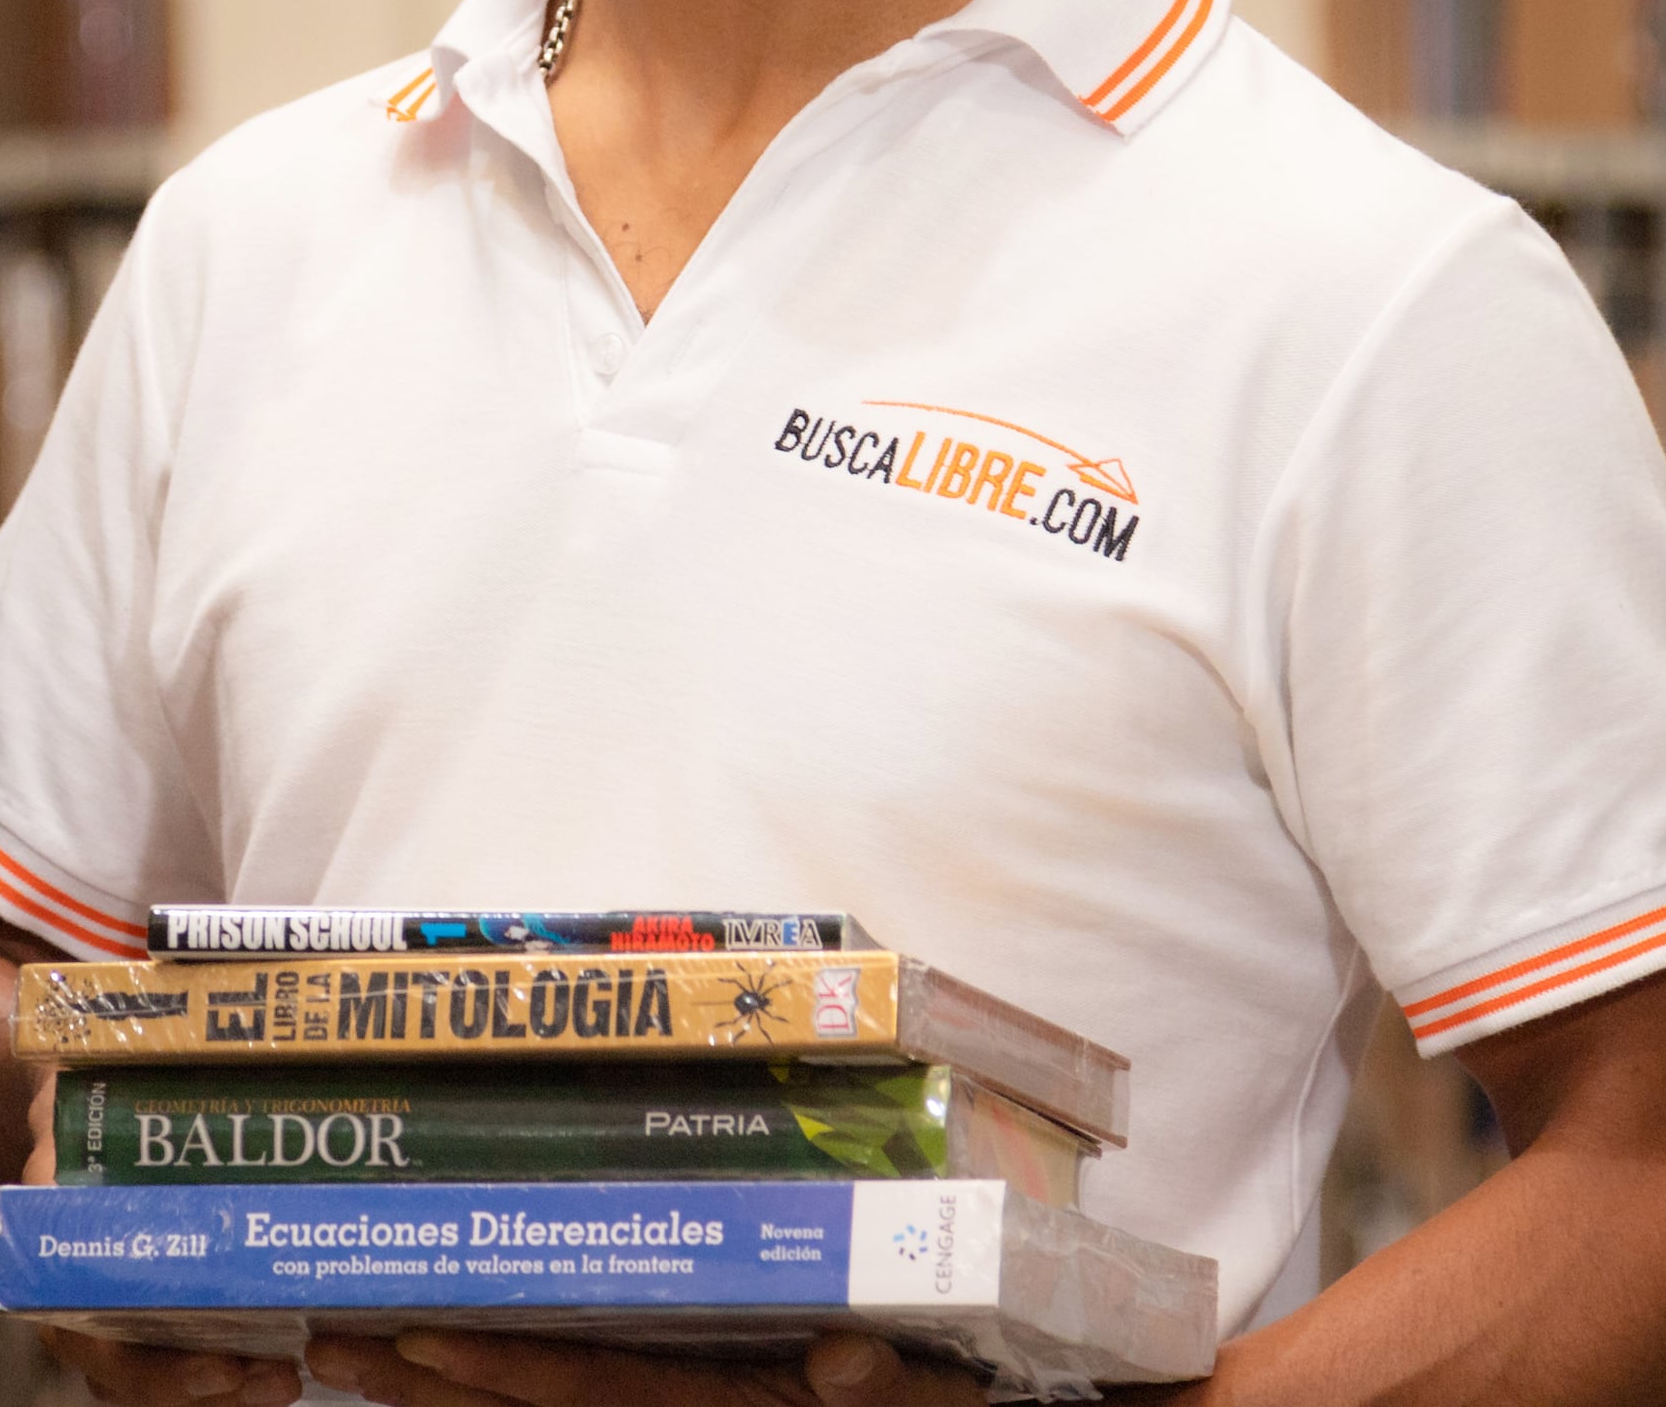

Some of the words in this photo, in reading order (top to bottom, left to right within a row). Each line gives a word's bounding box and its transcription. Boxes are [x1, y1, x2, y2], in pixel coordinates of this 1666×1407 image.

[774, 408, 1140, 562] BUSCALIBRE.COM
[166, 911, 286, 952] PRISON
[288, 912, 408, 952] SCHOOL
[205, 972, 269, 1042] EL
[272, 970, 300, 1043] LIBRO
[306, 972, 332, 1003] LA
[817, 975, 854, 1032] DK
[302, 1012, 329, 1042] DE
[87, 1081, 107, 1152] EDICIÓN
[134, 1112, 411, 1168] BALDOR
[38, 1234, 126, 1258] Dennis
[132, 1233, 160, 1260] G.
[166, 1233, 209, 1257] Zill
[244, 1212, 459, 1247] Ecuaciones
[469, 1210, 725, 1247] Diferenciales
[759, 1223, 825, 1241] Novena
[935, 1194, 958, 1295] CENGAGE
[272, 1259, 311, 1276] con
[315, 1255, 429, 1280] problemas
[433, 1254, 460, 1275] de
[465, 1254, 545, 1275] valores
[549, 1258, 577, 1275] en
[581, 1253, 604, 1275] la
[608, 1253, 695, 1275] frontera
[759, 1244, 823, 1263] edición
